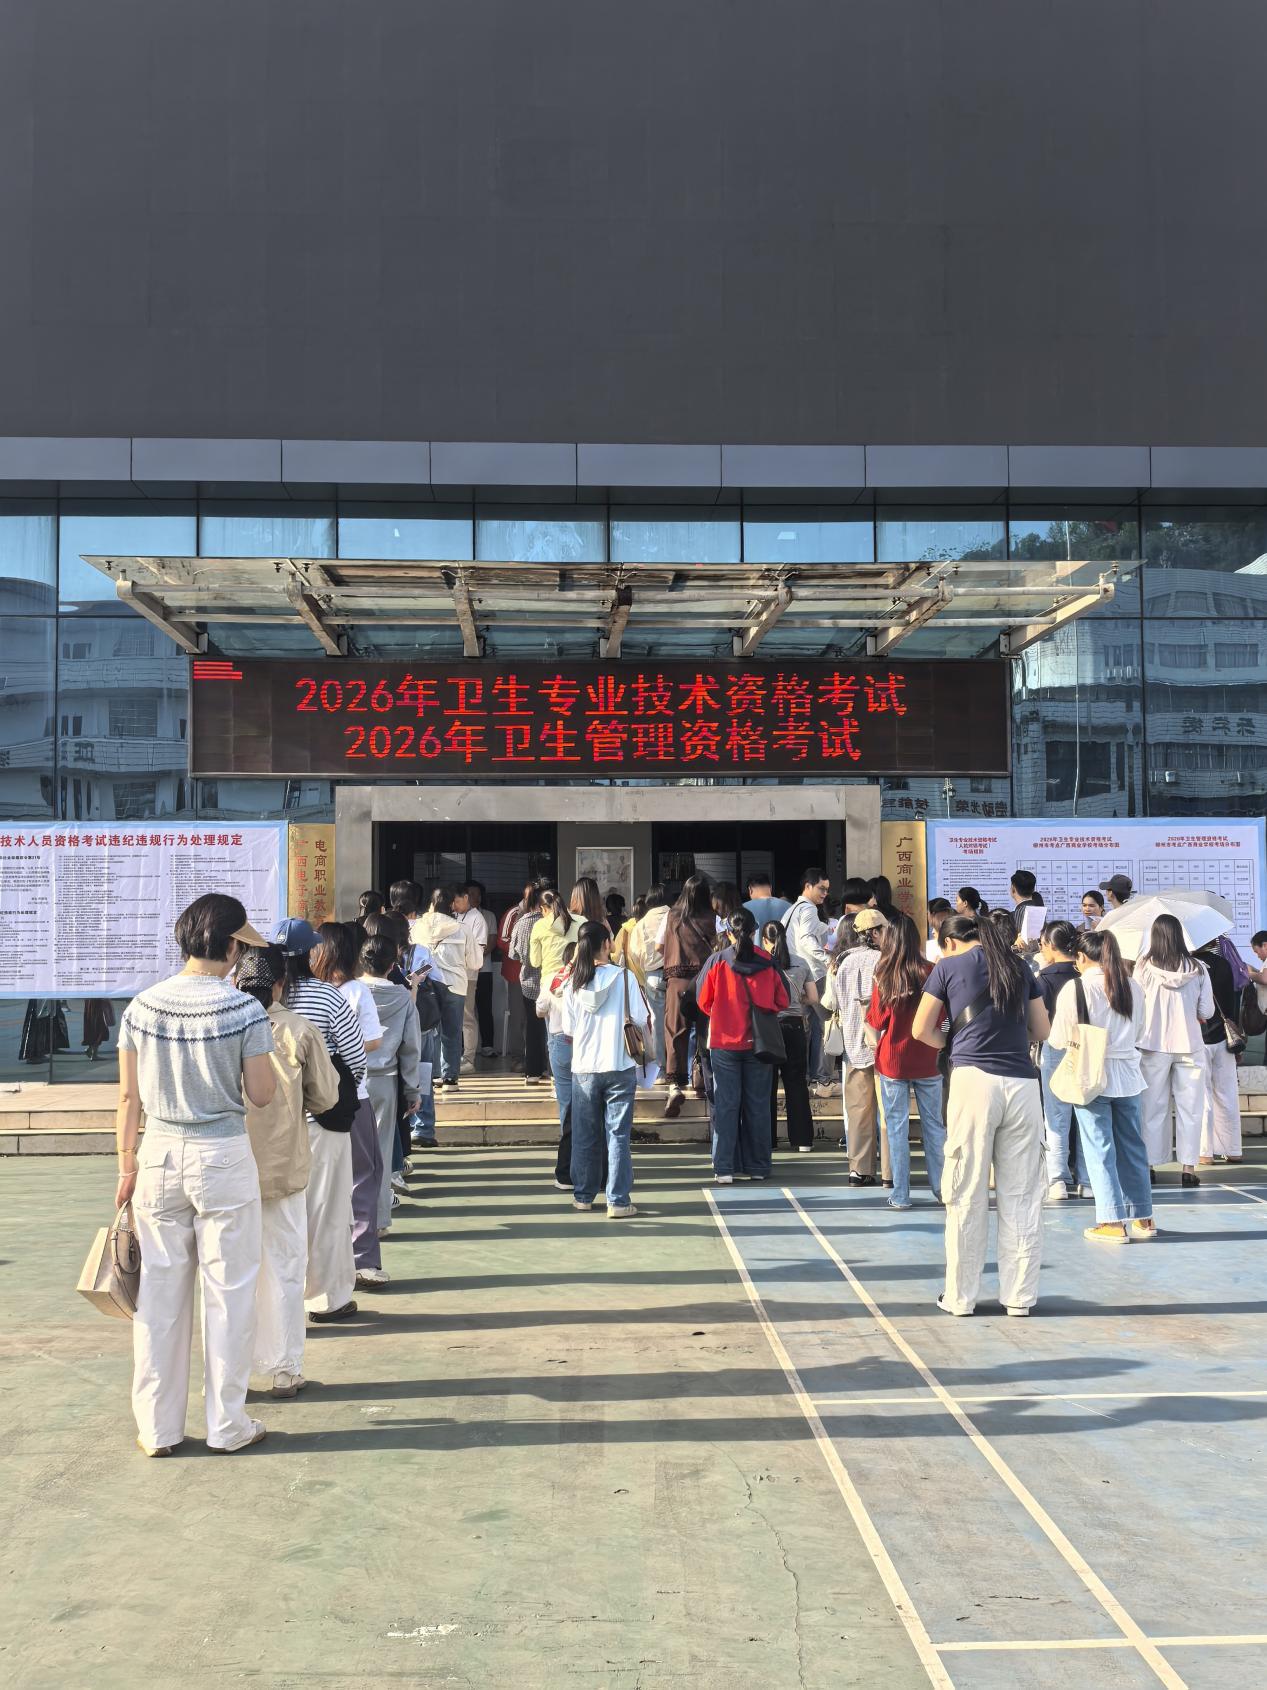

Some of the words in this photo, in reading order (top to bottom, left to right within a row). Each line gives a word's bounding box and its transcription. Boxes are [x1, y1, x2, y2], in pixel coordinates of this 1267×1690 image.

[295, 672, 907, 716] 2026年卫生专业技术资格考试
[344, 718, 862, 763] 2026年卫生管理资格考试
[0, 834, 243, 848] 技术人员资格考试违纪违规行为处理规定
